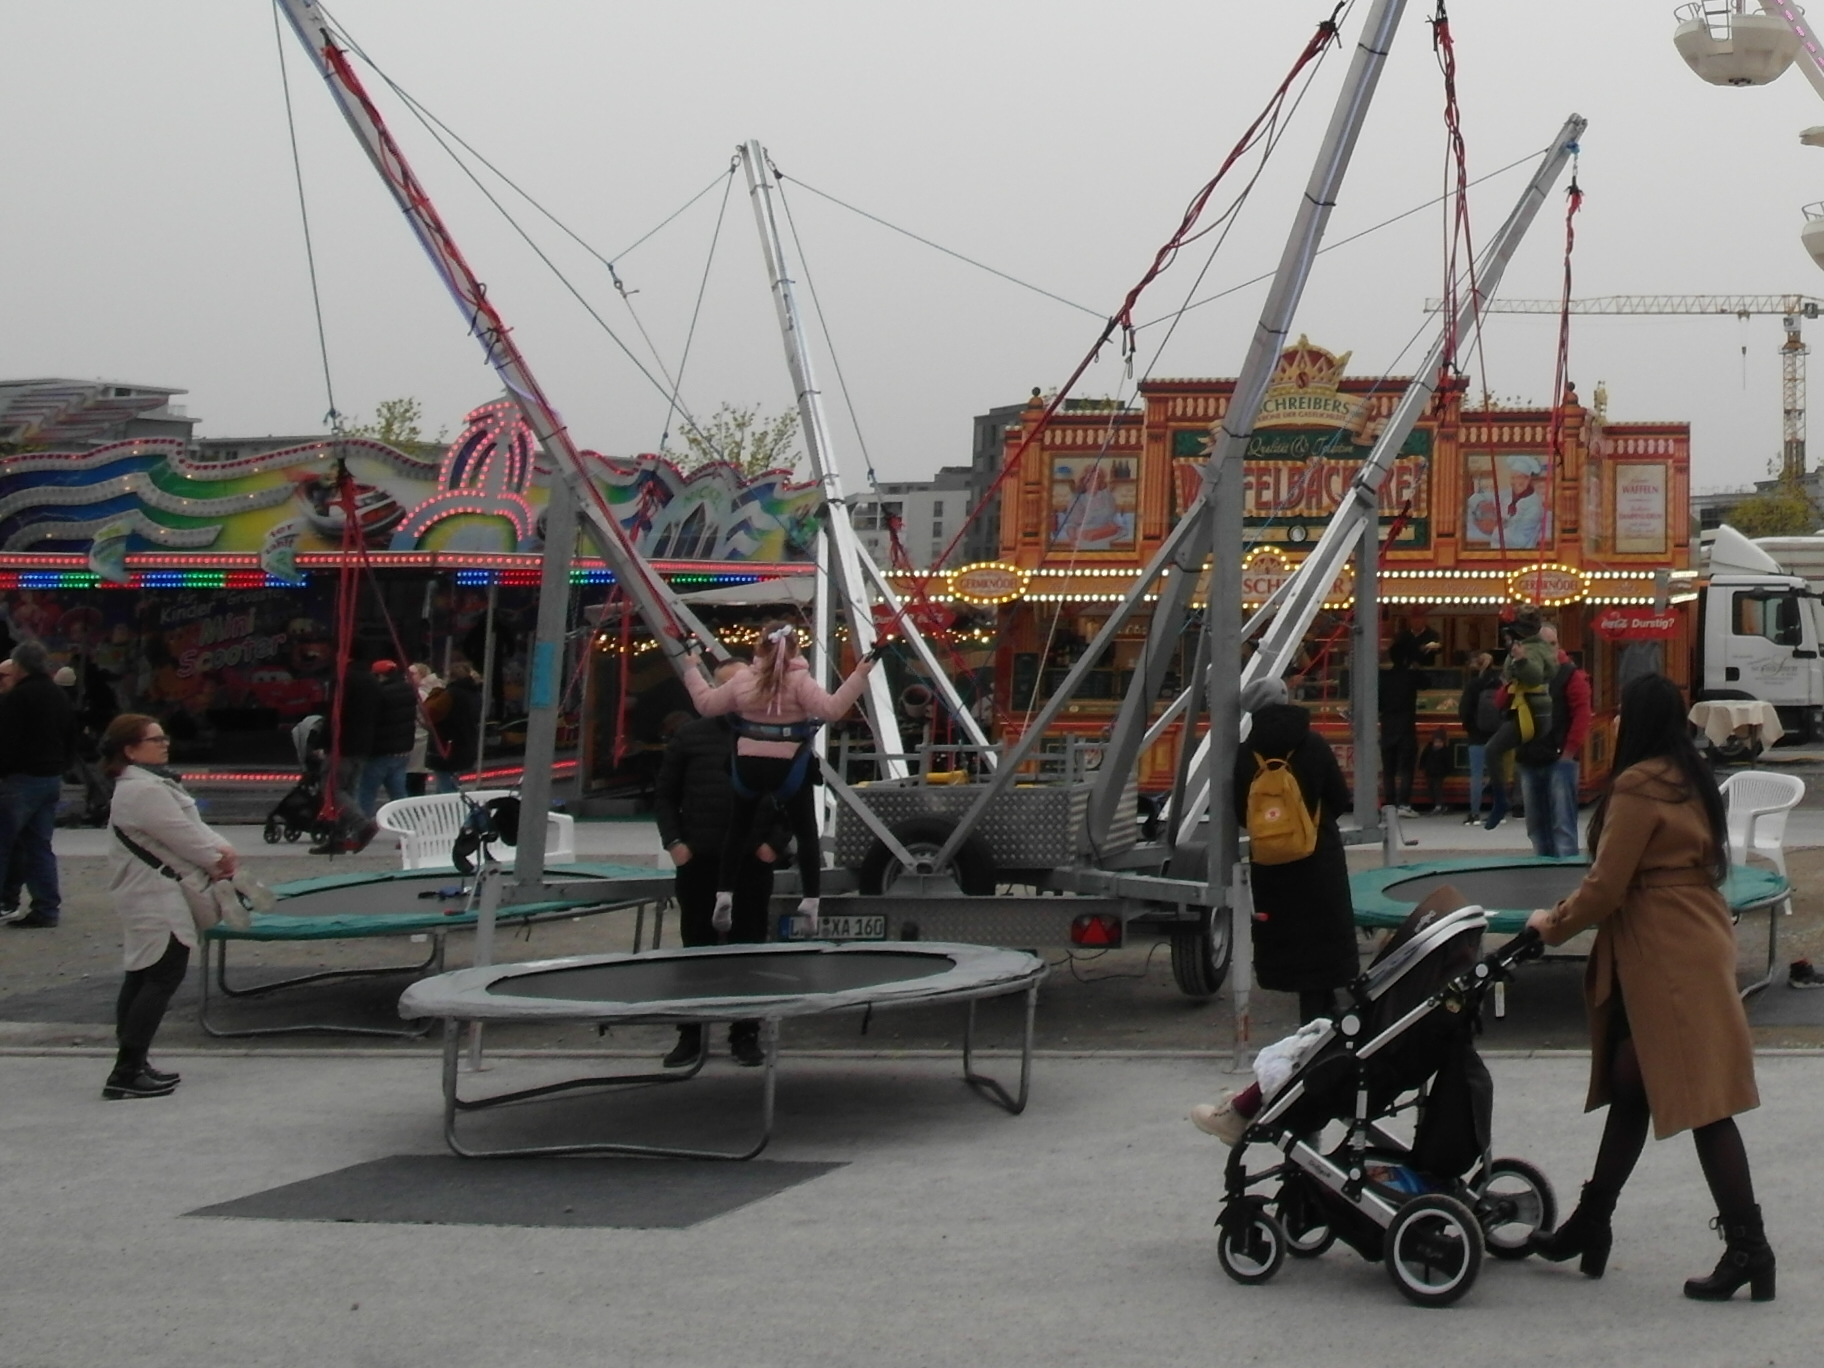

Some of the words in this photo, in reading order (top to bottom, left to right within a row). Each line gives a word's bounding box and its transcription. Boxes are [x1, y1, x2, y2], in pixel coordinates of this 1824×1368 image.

[1259, 396, 1350, 415] CHREIBERS
[1631, 617, 1676, 630] Durstig?
[176, 632, 288, 679] Scooter
[831, 918, 850, 936] XA
[854, 918, 884, 936] 160
